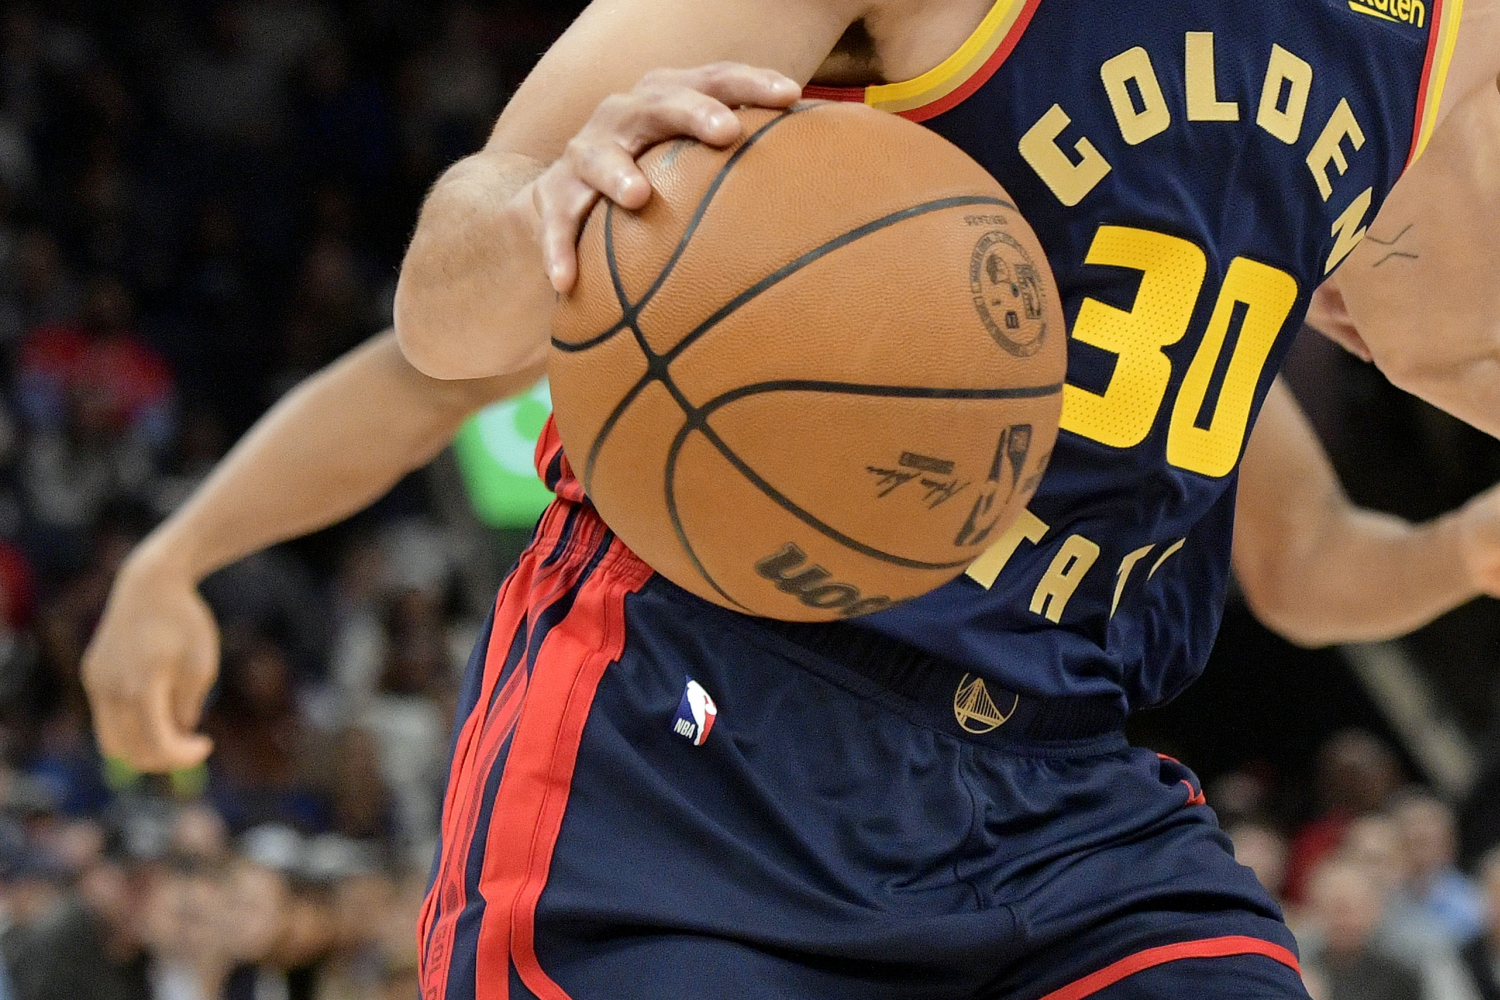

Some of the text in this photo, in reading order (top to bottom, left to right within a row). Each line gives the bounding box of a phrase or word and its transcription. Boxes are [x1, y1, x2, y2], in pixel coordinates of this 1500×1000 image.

[1018, 31, 1373, 275] GOLDEN
[1058, 225, 1298, 478] 30
[673, 717, 696, 739] NBA
